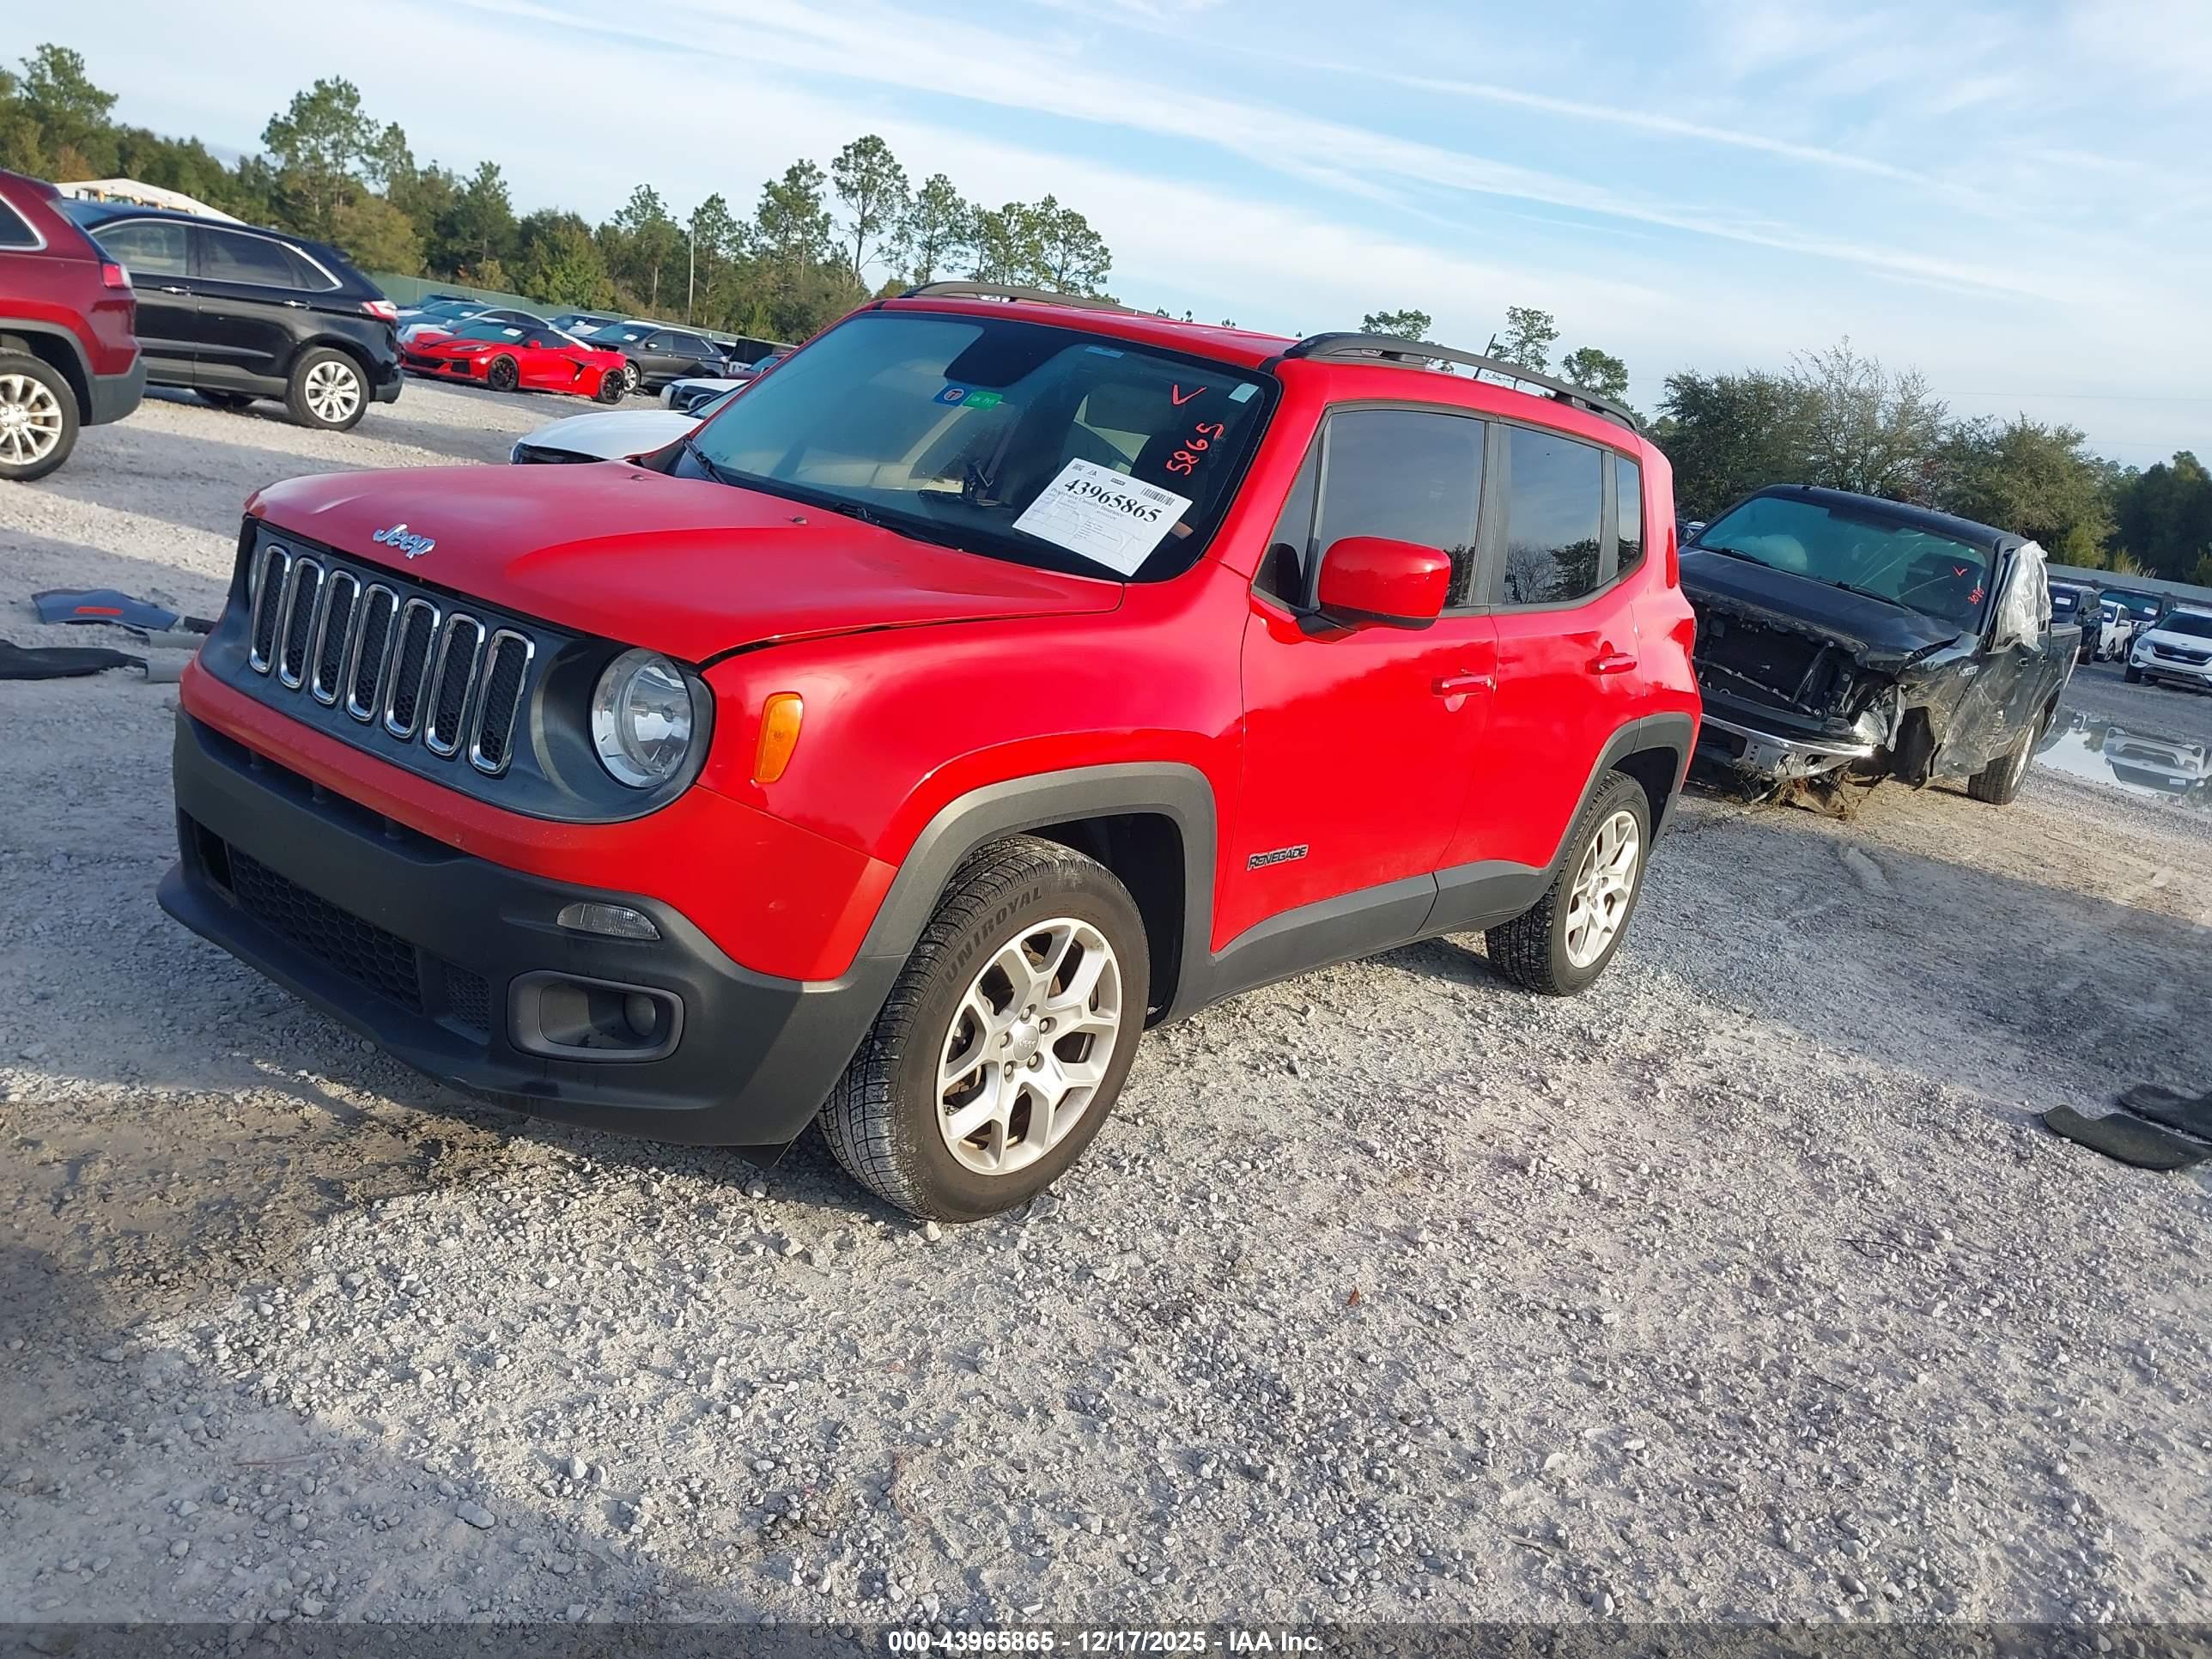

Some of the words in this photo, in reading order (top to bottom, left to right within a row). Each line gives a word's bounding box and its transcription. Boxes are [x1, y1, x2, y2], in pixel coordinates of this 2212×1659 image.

[1065, 478, 1163, 522] 43965865
[373, 524, 435, 559] Jeep
[1247, 845, 1309, 871] RENEGADE
[946, 886, 1042, 982] UNIROYAL
